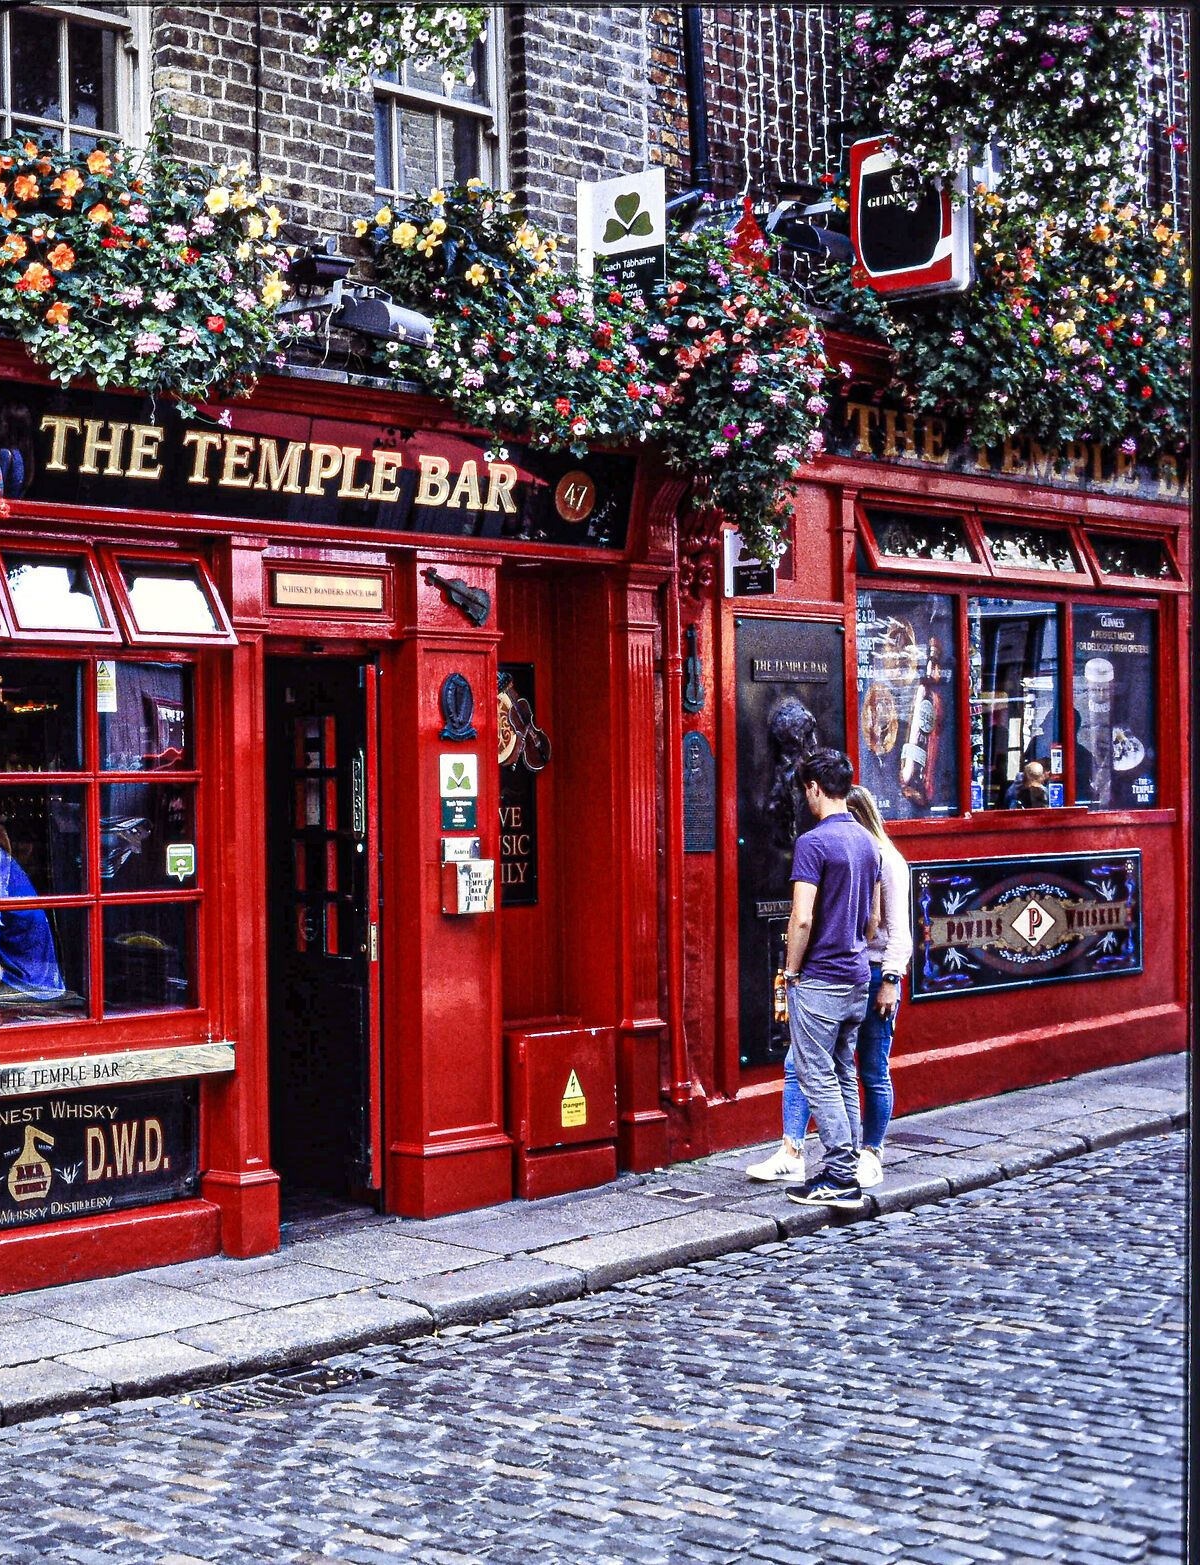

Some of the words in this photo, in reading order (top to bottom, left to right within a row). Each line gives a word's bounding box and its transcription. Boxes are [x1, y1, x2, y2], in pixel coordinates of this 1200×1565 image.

[867, 191, 909, 208] GUINN
[622, 270, 636, 279] Pub
[846, 401, 949, 465] THE
[1157, 454, 1190, 499] B
[39, 415, 165, 481] THE
[183, 429, 402, 503] TEMPLE
[414, 454, 518, 514] BAR
[564, 482, 588, 511] 47
[282, 585, 312, 595] WHISKEY
[1117, 632, 1135, 640] MATCH
[754, 660, 772, 671] THE
[776, 660, 808, 672] TEMPLE
[810, 661, 828, 673] BAR
[1132, 785, 1154, 794] TEMPLE
[1137, 794, 1149, 802] BAR
[465, 894, 488, 902] DUBLIN
[946, 917, 1002, 942] POWERS
[1027, 907, 1043, 938] P
[1065, 907, 1121, 930] WHISKEY
[0, 1072, 25, 1089] THE
[32, 1065, 87, 1085] TEMPLE
[93, 1062, 120, 1079] BAR
[50, 1101, 119, 1120] WHISKY
[87, 1119, 169, 1181] D.W.D.
[50, 1196, 113, 1215] DISTILLERY
